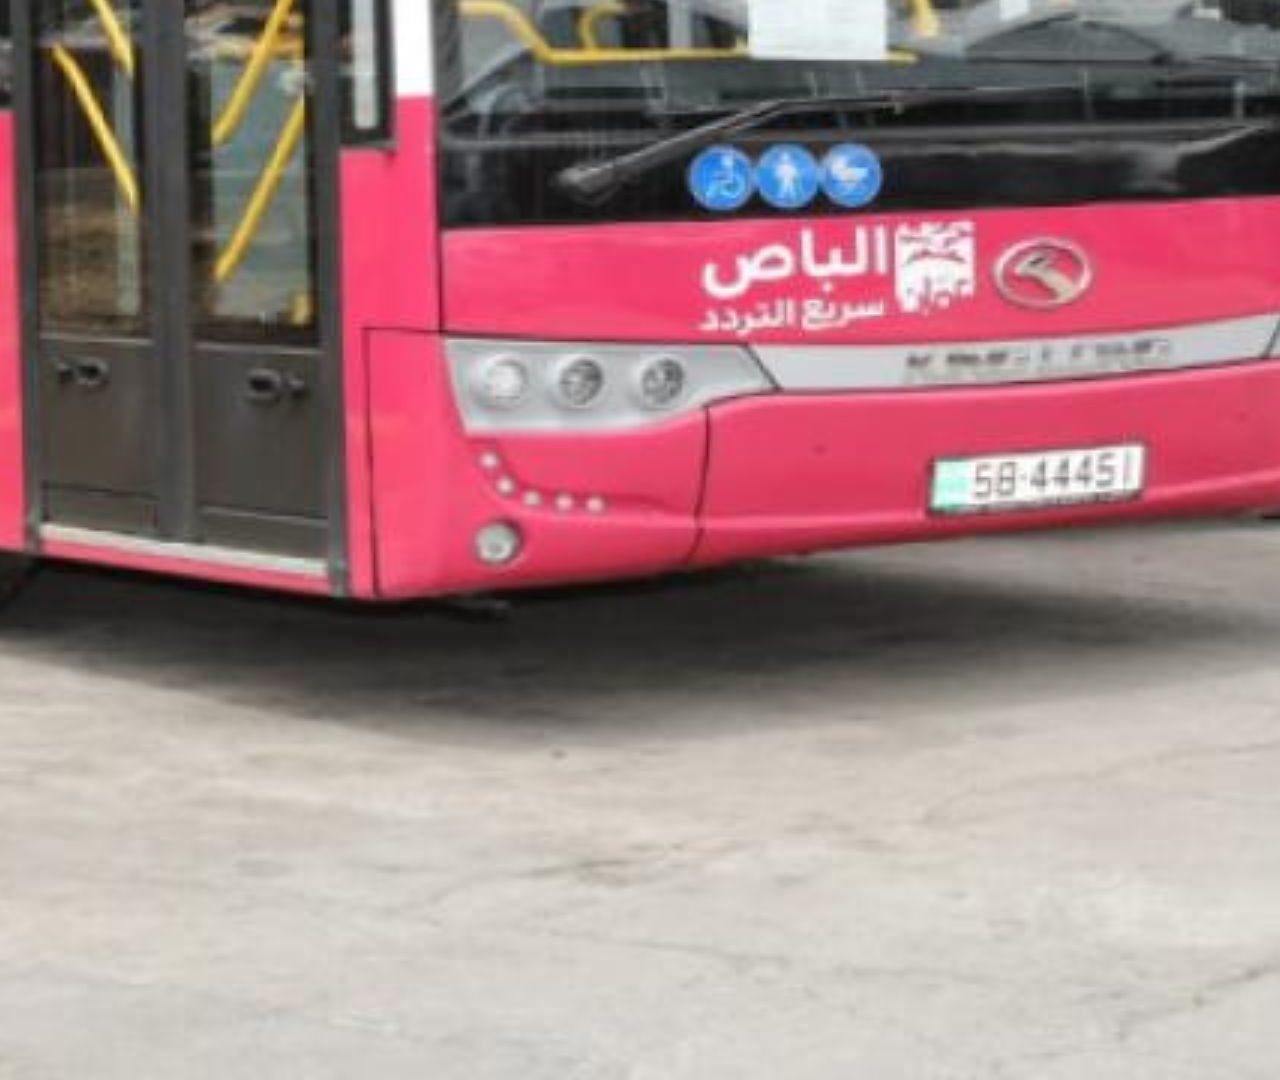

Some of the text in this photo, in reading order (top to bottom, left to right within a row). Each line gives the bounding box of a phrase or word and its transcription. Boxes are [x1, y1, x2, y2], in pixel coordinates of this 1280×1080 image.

[701, 224, 888, 298] الباص
[699, 298, 886, 337] سريع التردد
